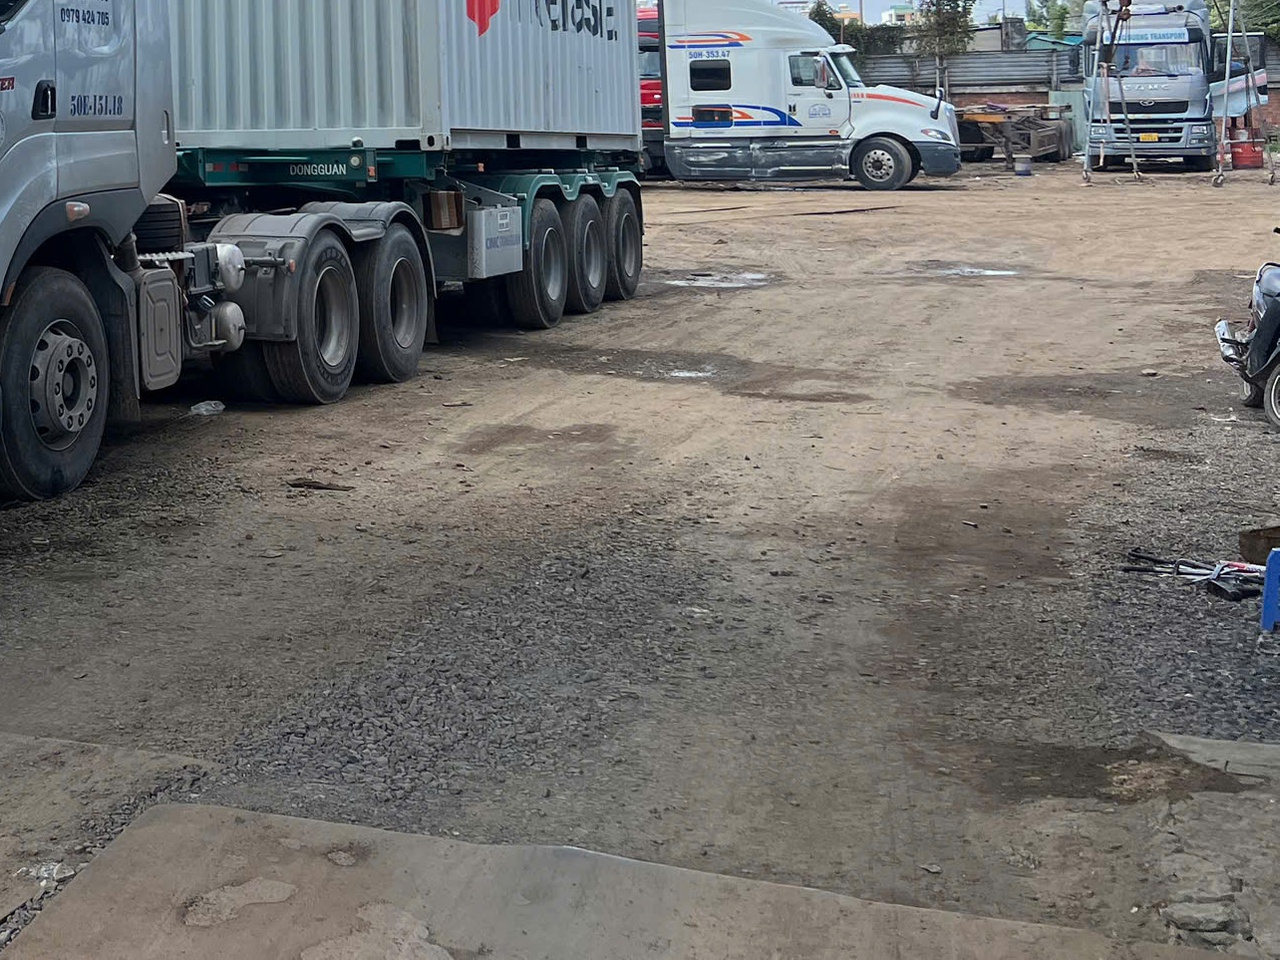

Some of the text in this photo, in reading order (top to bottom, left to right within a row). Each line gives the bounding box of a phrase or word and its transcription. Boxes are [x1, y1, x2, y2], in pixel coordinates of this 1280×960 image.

[60, 8, 109, 26] 0979 424 705
[1150, 32, 1186, 41] TRANSPORT
[688, 50, 731, 59] 50H-353.47
[1122, 83, 1170, 92] CAMC
[70, 94, 123, 117] 50E-151.18
[289, 163, 347, 175] DONGGUAN
